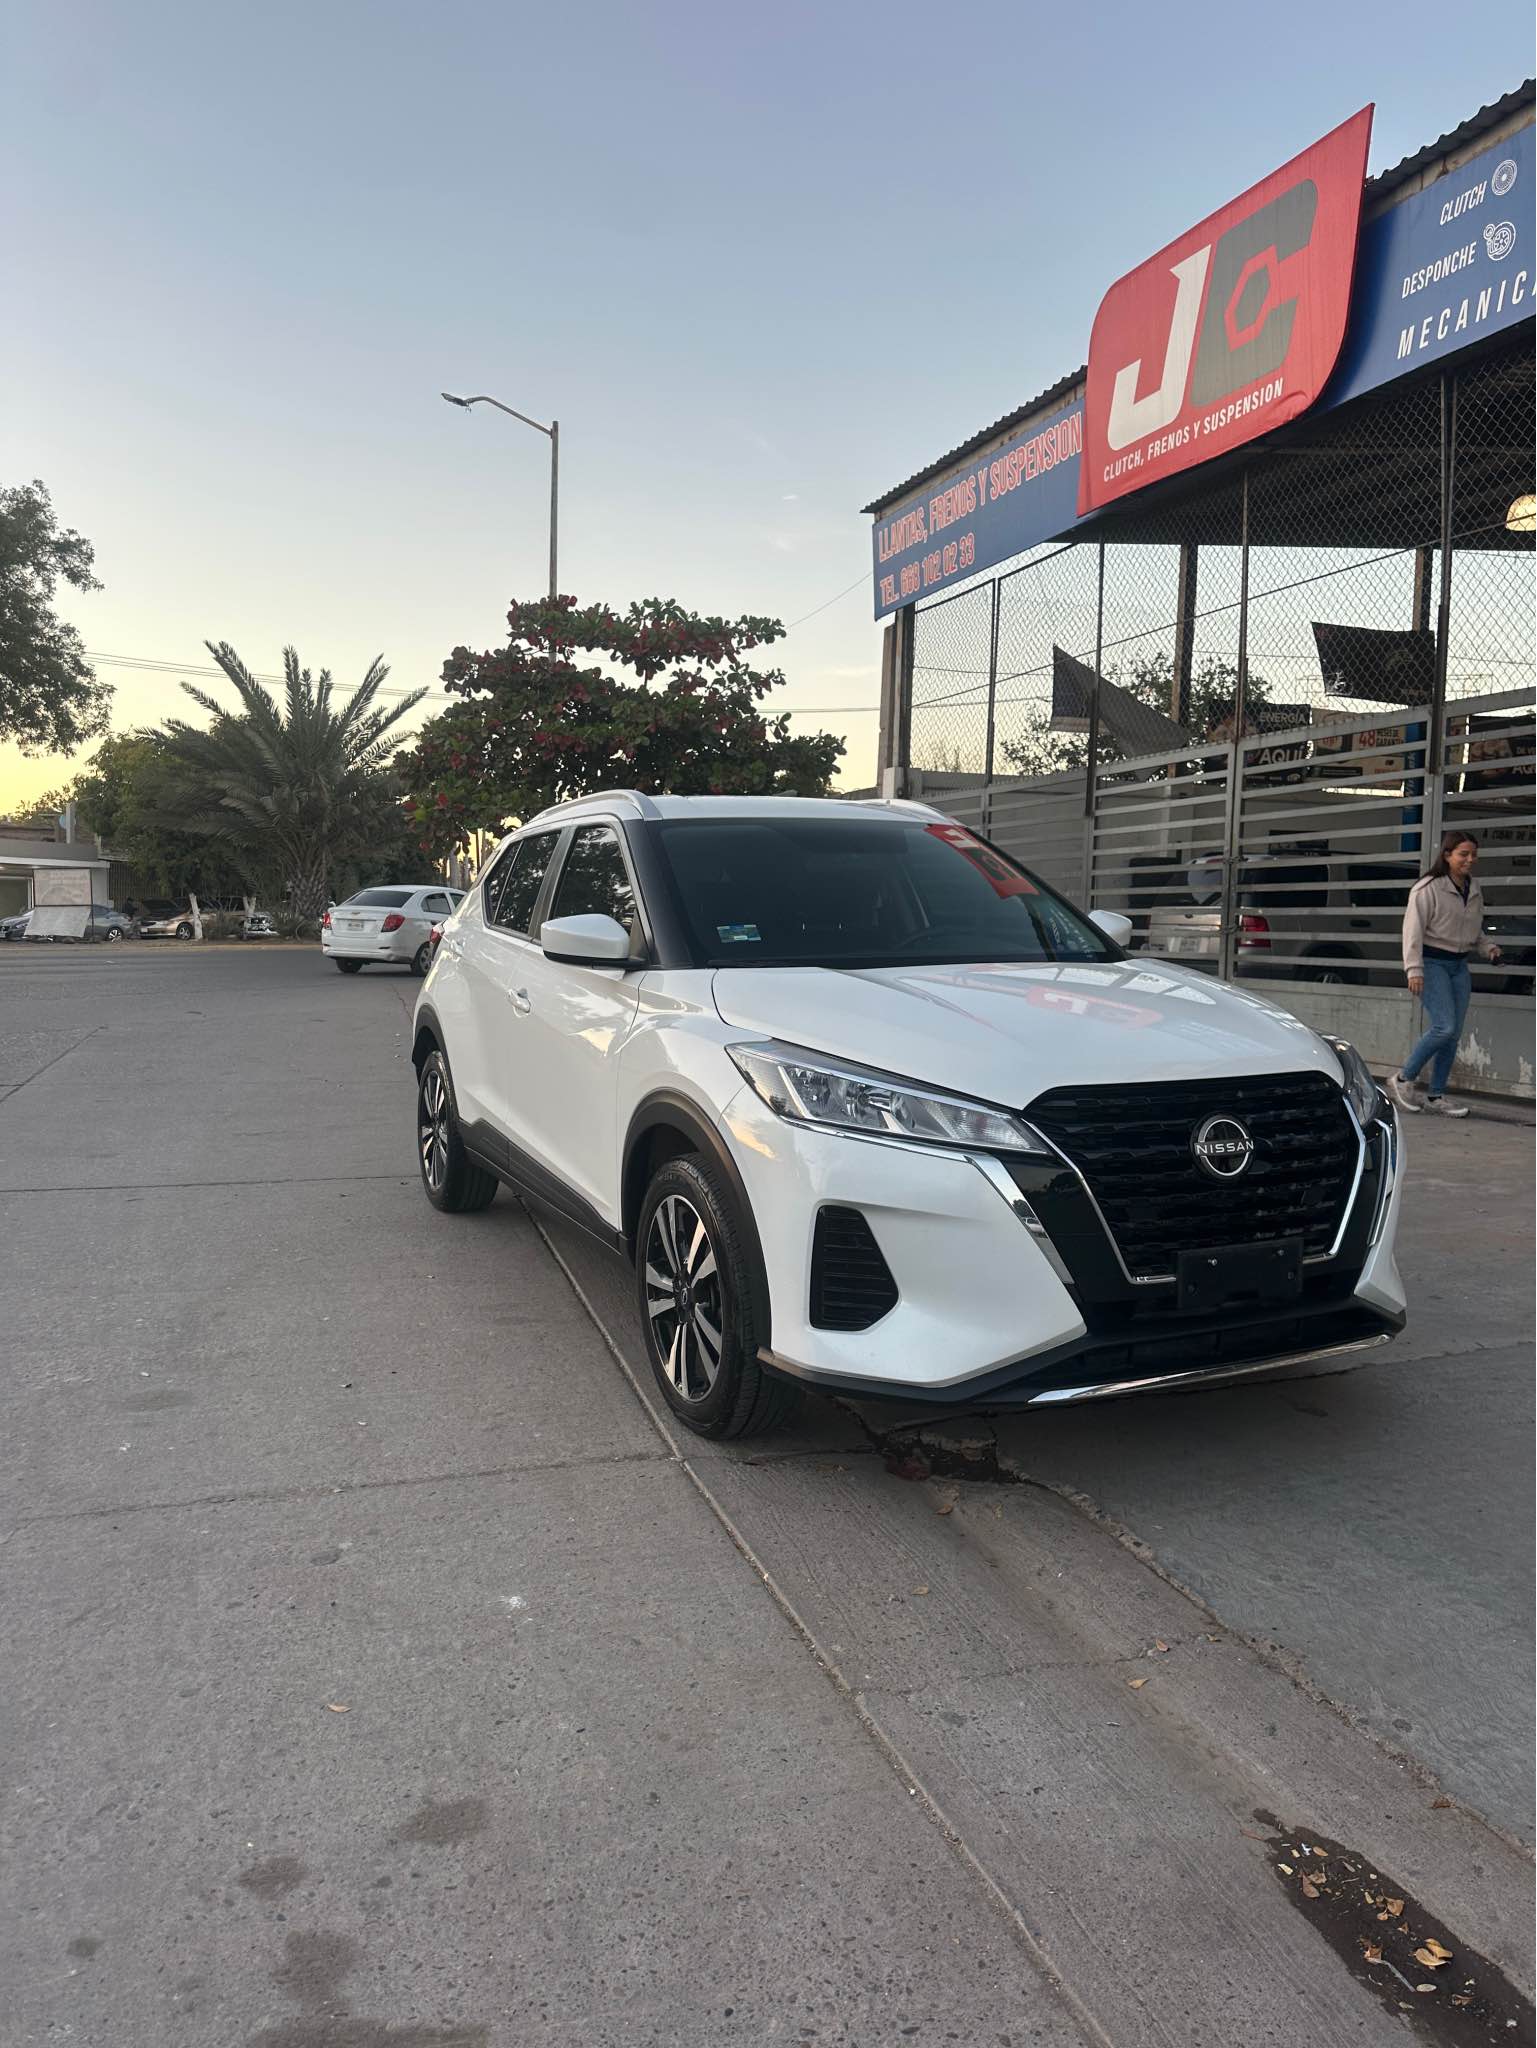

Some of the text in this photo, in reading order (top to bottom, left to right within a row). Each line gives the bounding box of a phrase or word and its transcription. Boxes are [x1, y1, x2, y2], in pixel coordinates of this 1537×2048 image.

[1439, 180, 1488, 226] CLUTCH
[1401, 241, 1477, 300] DESPONCHE
[1107, 178, 1318, 451] JC
[1396, 270, 1536, 360] MECANIC
[1103, 377, 1284, 482] CLUTCH, FRENOS Y SUSPENSION
[878, 411, 1083, 563] LLANTAS, FRENOS Y SUSPENSION
[879, 573, 900, 608] TEL.
[922, 549, 942, 587] 102
[943, 540, 959, 578] 02
[959, 531, 976, 570] 33
[1359, 730, 1376, 748] 48
[1195, 1140, 1254, 1155] NISSAN
